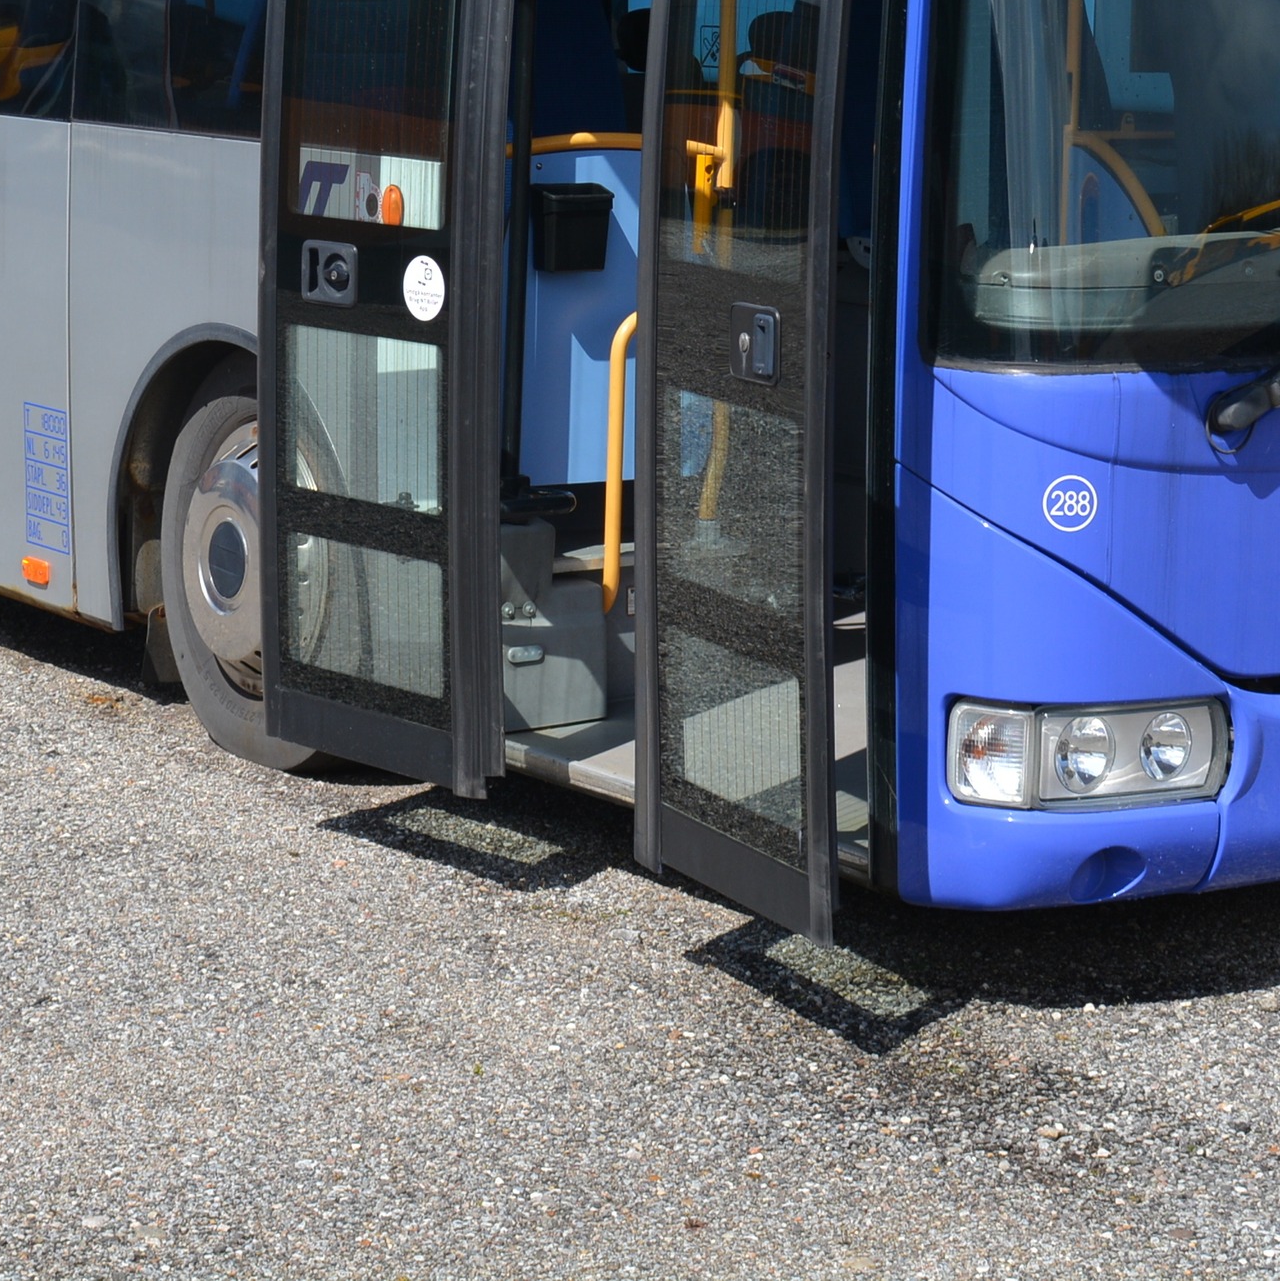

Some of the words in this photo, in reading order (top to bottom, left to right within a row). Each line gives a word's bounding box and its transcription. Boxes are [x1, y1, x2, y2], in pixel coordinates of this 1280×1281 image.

[25, 409, 30, 426] T
[41, 413, 66, 435] 18000
[26, 436, 36, 456] NL
[1049, 490, 1091, 517] 288
